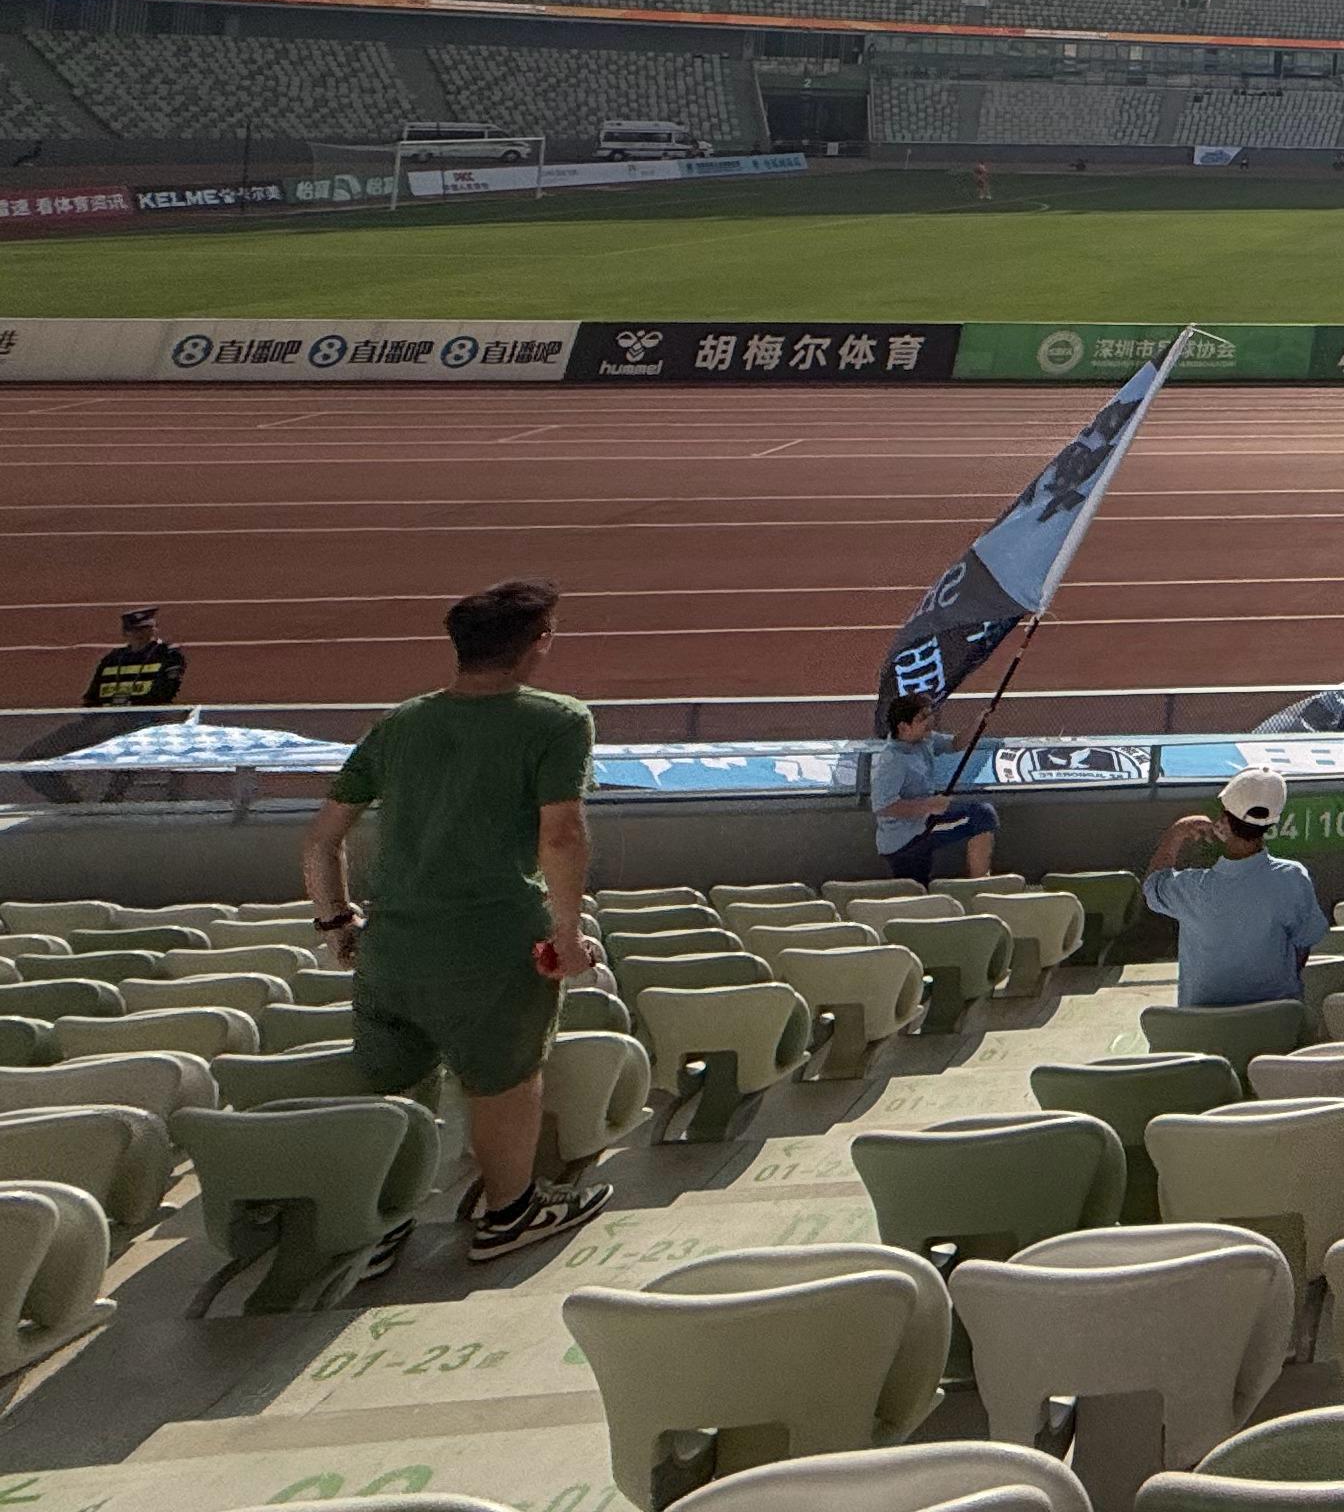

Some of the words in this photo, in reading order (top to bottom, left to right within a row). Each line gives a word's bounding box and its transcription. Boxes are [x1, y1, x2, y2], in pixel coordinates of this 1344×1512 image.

[138, 189, 222, 209] KELME
[212, 339, 301, 364] 直播吧
[348, 340, 434, 364] 直播吧
[480, 341, 563, 364] 直播吧
[695, 334, 925, 371] 胡梅尔体育
[599, 360, 663, 375] hummel
